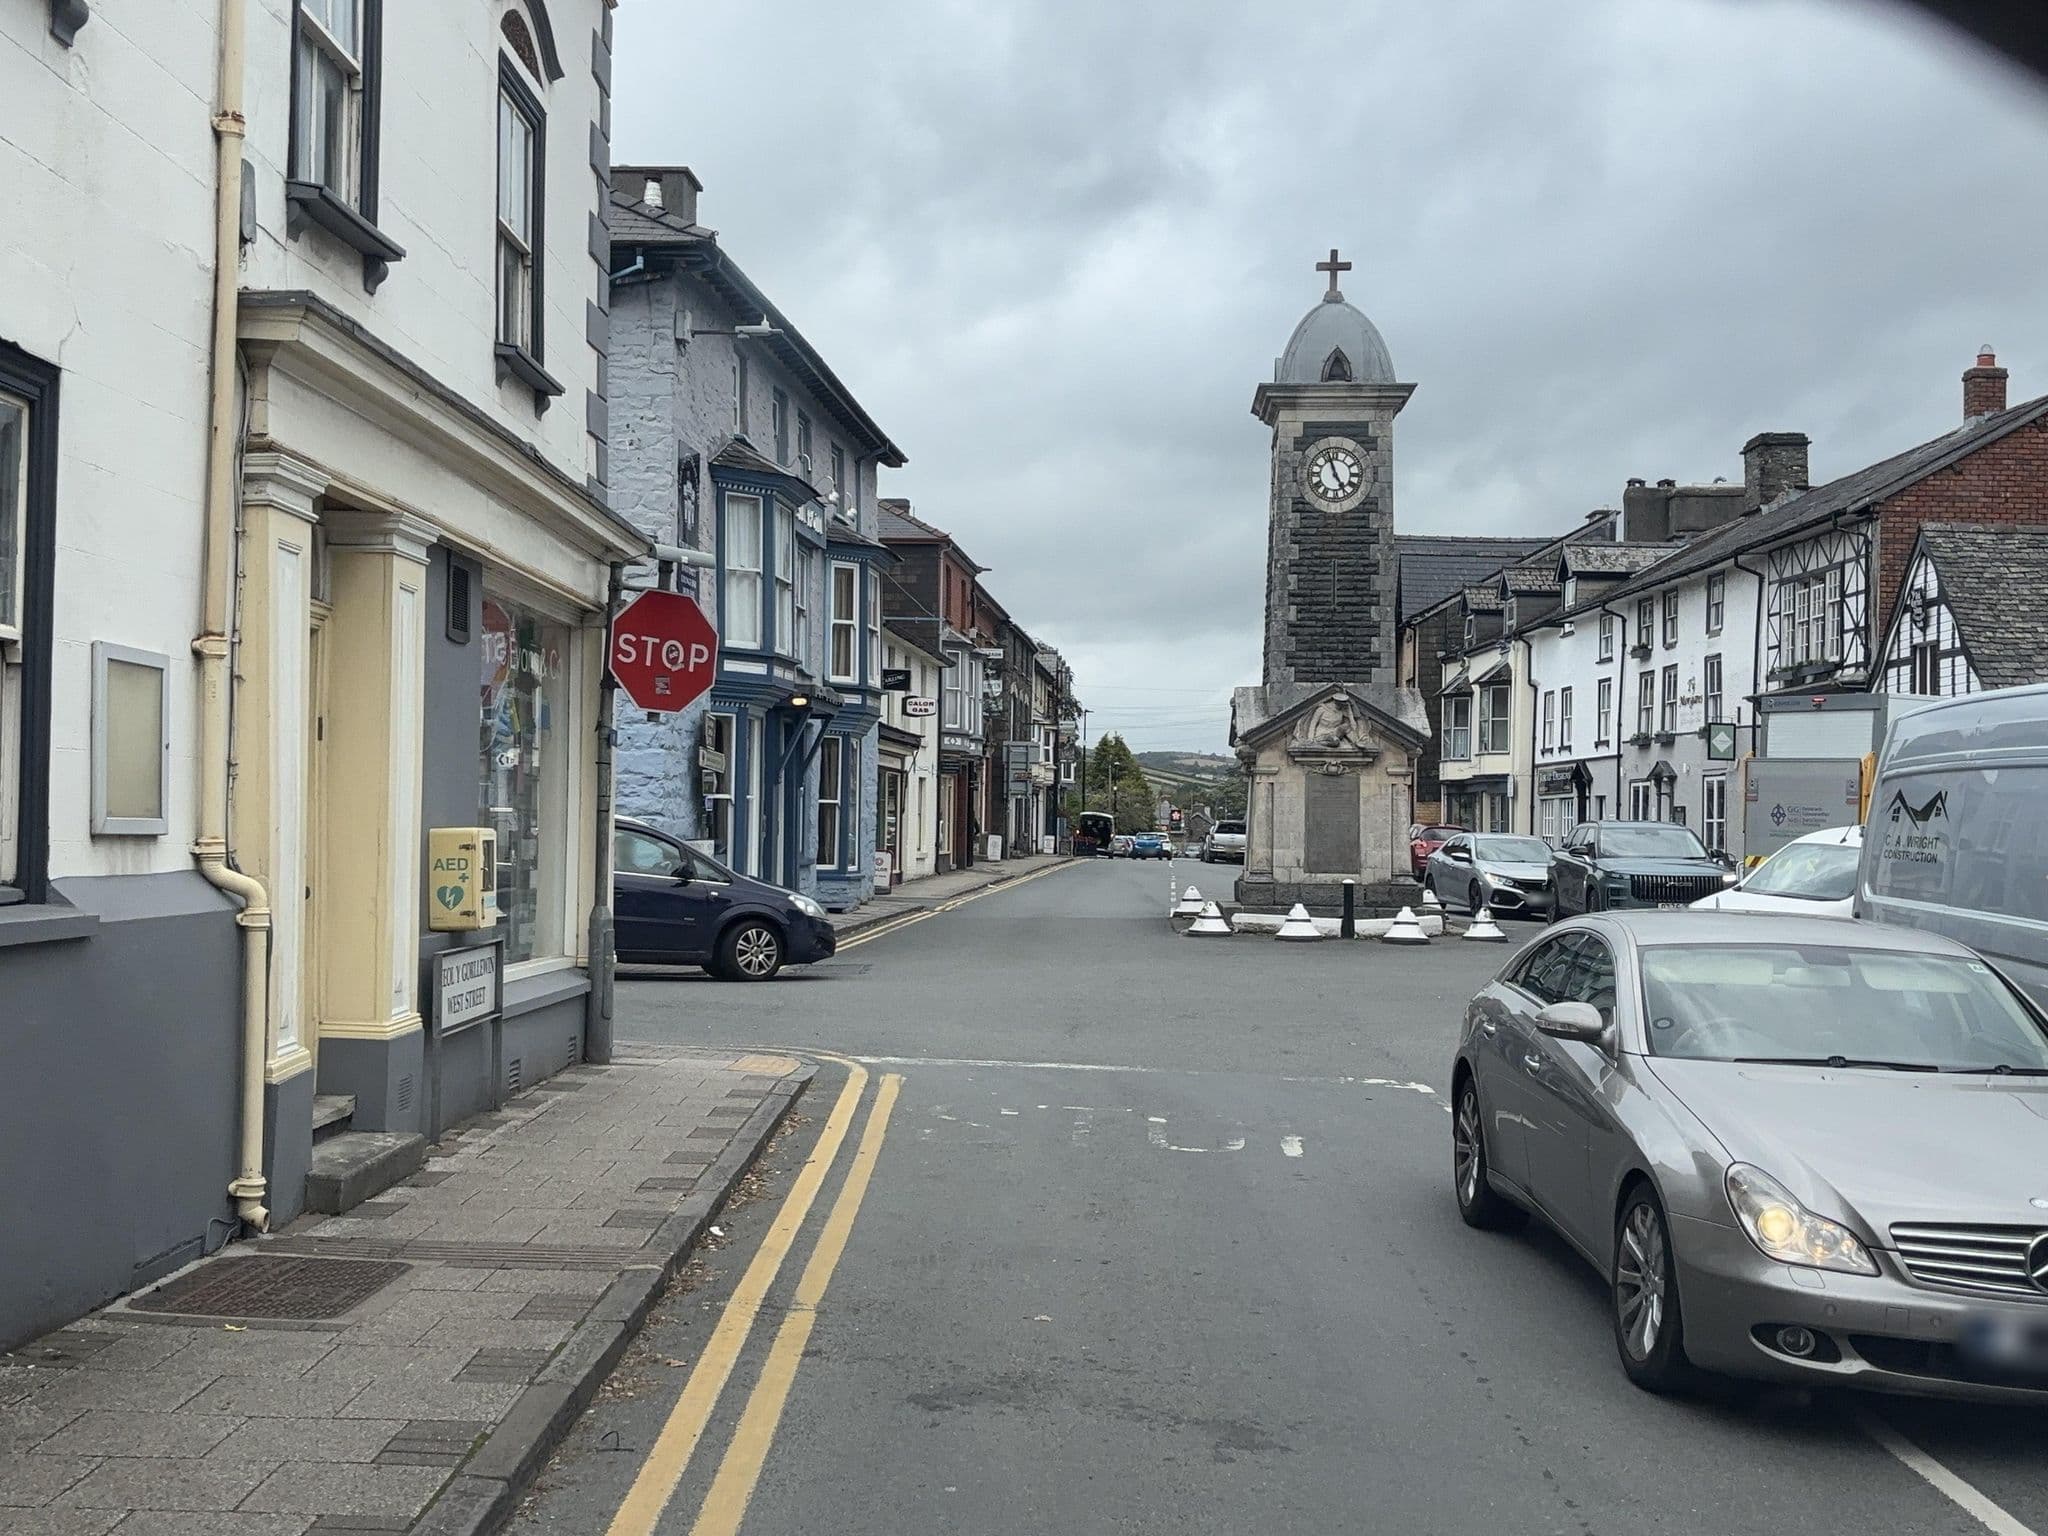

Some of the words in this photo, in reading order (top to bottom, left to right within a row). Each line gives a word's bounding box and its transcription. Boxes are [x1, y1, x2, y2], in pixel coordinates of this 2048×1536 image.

[617, 633, 709, 672] STOP
[1907, 835, 1940, 849] WRIGHT
[1883, 849, 1938, 863] CONSTRUCTION
[433, 858, 469, 871] AED
[447, 994, 464, 1014] WEST
[465, 987, 486, 1009] STREET
